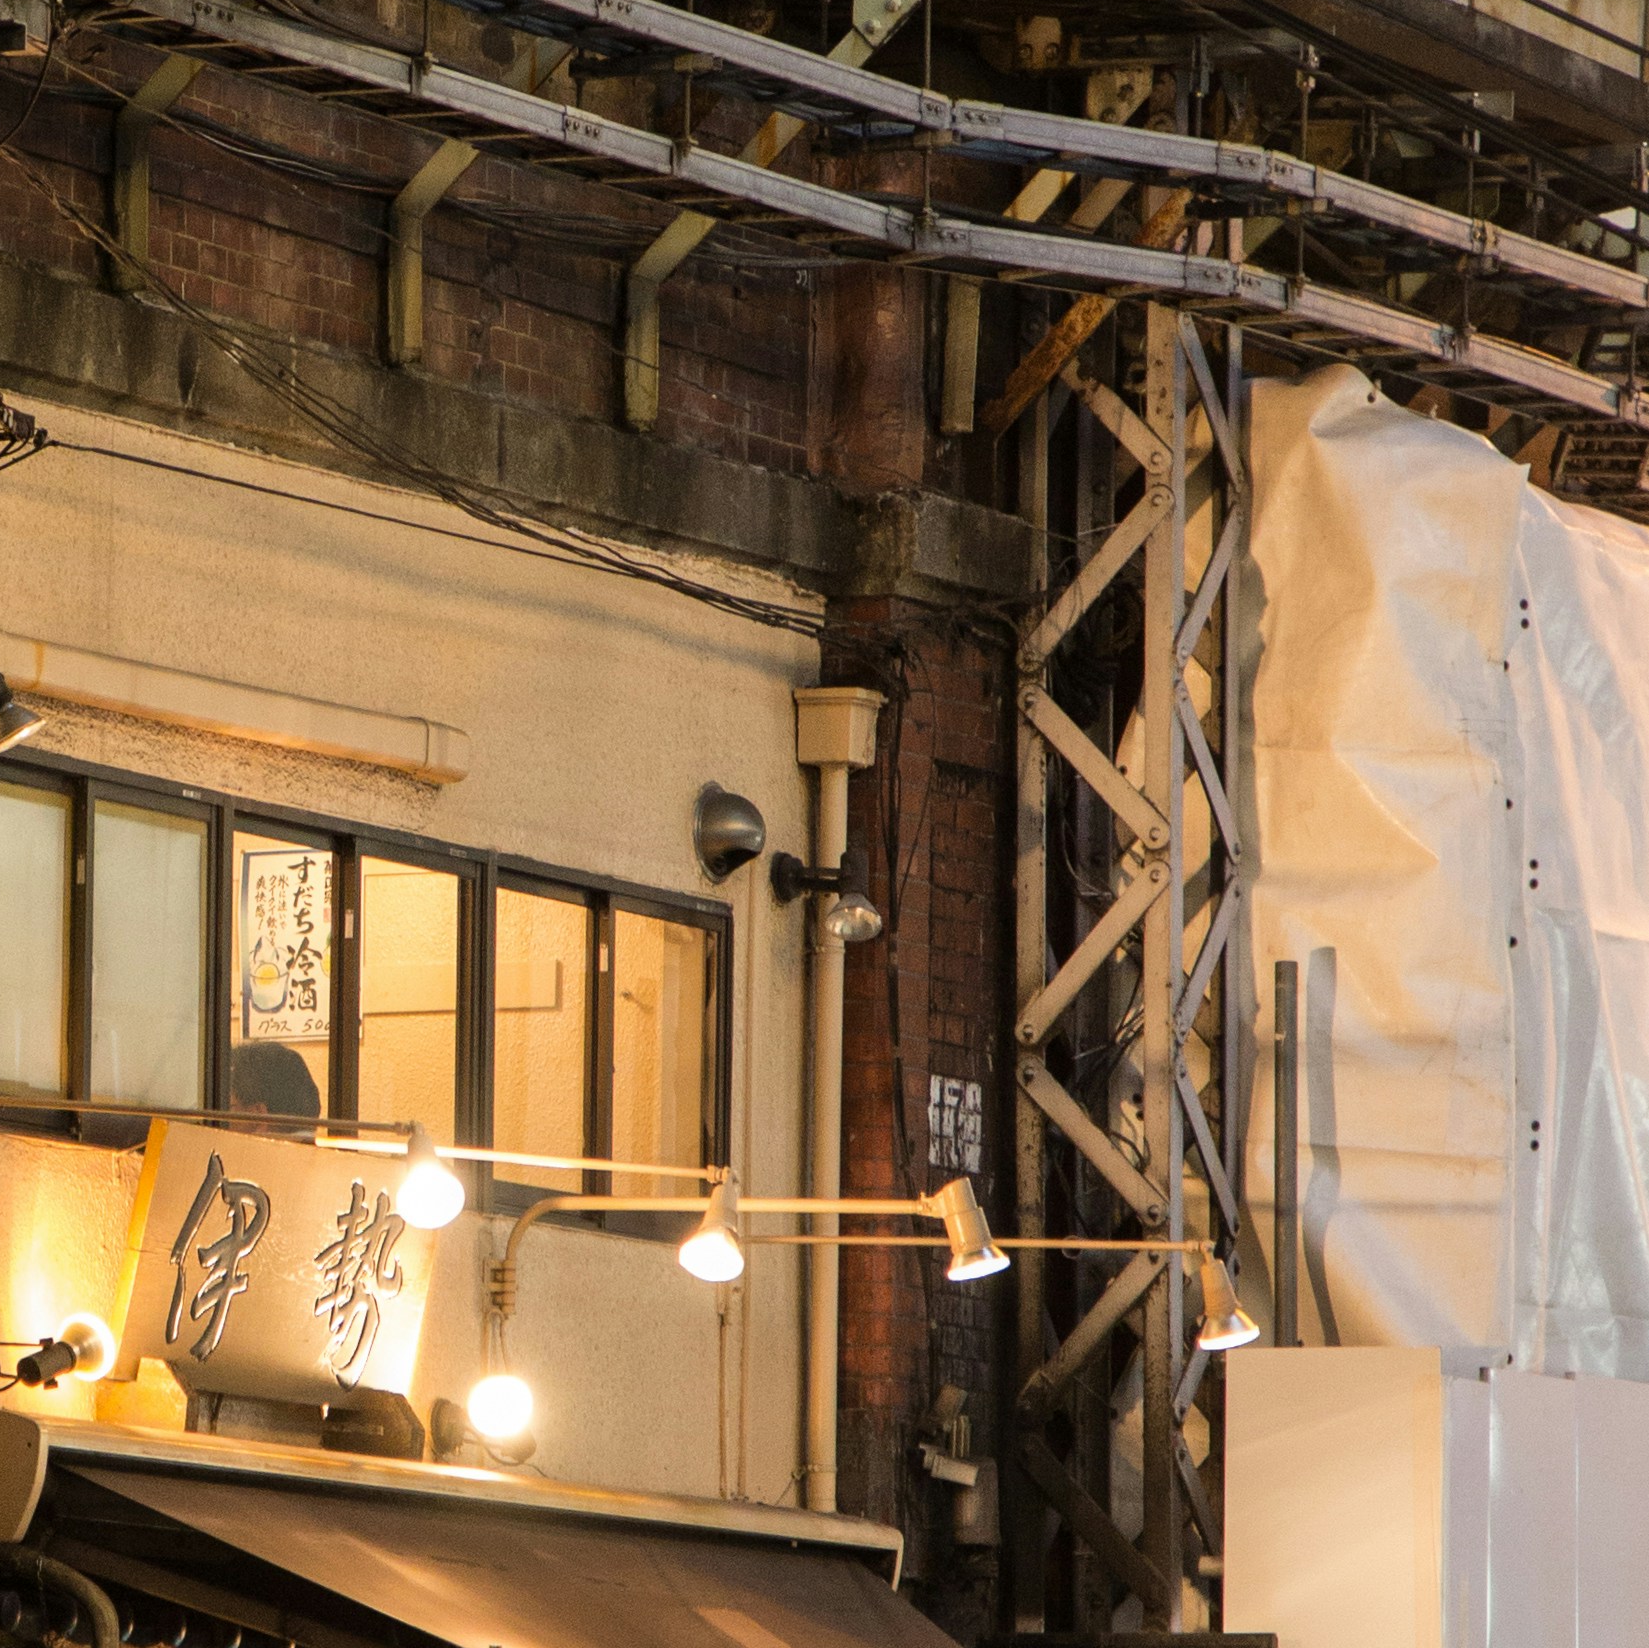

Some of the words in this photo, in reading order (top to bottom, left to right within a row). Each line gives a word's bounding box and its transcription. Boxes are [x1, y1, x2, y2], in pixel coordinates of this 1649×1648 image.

[286, 856, 323, 1012] すだち冷酒
[165, 1148, 406, 1392] 伊勢
